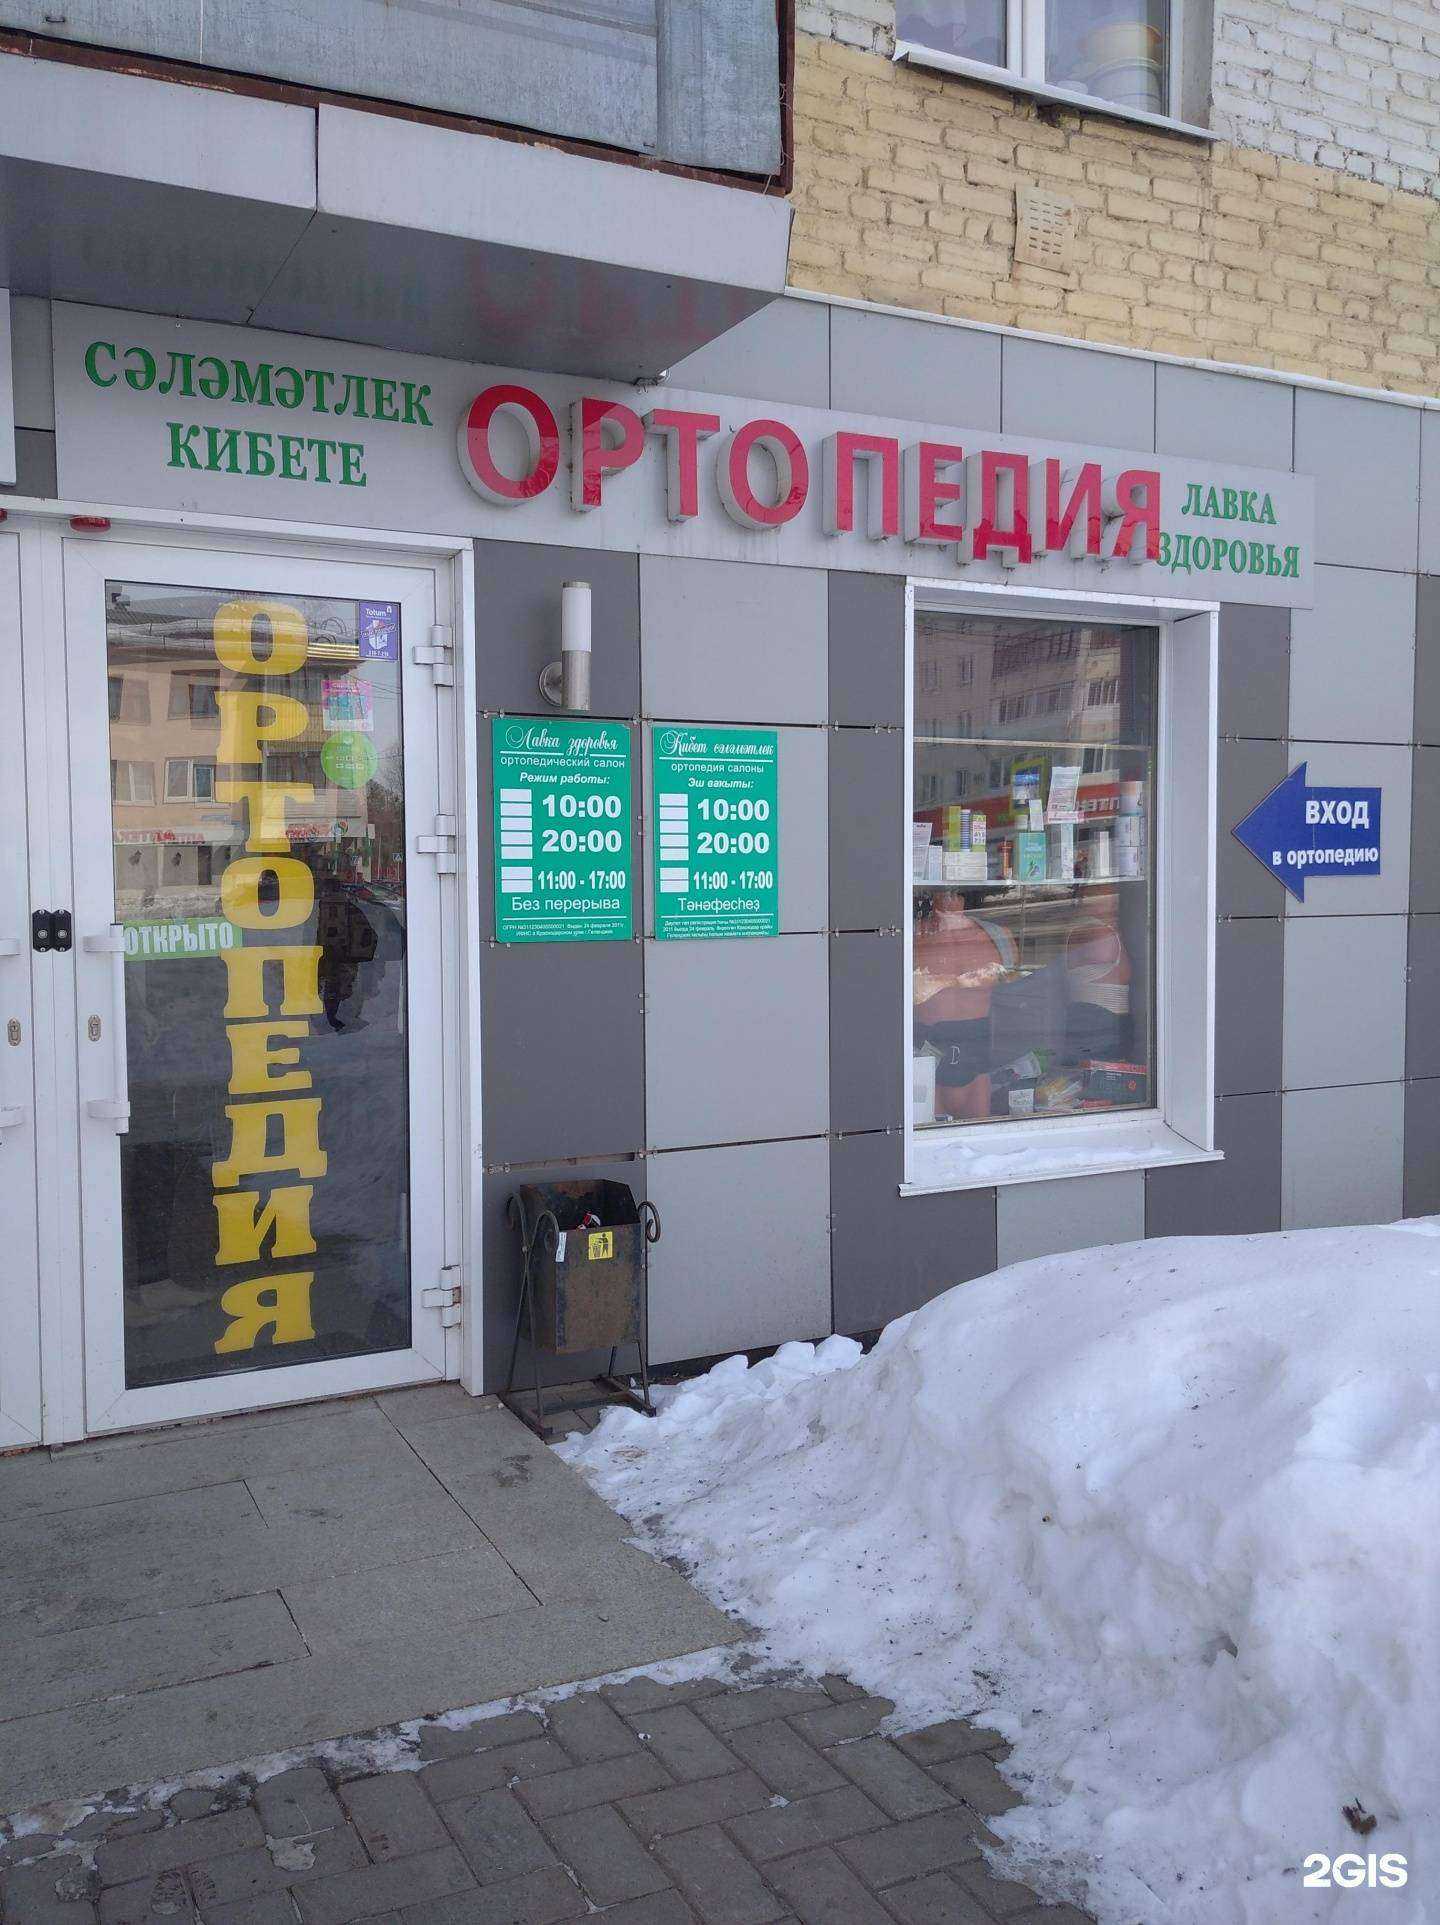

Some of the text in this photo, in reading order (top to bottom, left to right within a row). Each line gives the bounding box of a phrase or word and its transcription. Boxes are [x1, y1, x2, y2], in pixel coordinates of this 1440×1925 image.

[84, 341, 434, 427] СӘЛӘМӘТЛЕК
[166, 422, 367, 488] КИБЕТЕ
[466, 384, 1161, 565] ОРТОПЕДИЯ
[1181, 483, 1277, 525] ЛАВКА
[1157, 531, 1299, 578] ЗДОРОВЬЯ
[505, 725, 619, 757] Лавка здоровья
[500, 755, 626, 768] ортопедический салон
[671, 763, 725, 773] ортопедия
[519, 772, 610, 785] Режим работы:
[687, 777, 705, 788] Эш
[542, 794, 622, 818] 10:00
[697, 799, 770, 821] 10:00
[1305, 800, 1370, 829] ВХОД
[541, 829, 622, 853] 20:00
[696, 832, 770, 854] 20:00
[1272, 847, 1379, 870] в ортопедию
[537, 870, 576, 890] 11:00
[588, 870, 626, 889] 17:00
[693, 871, 728, 890] 11:00
[739, 870, 773, 889] 17:00
[511, 896, 620, 912] Без перерыва
[124, 922, 234, 955] ОТКРЫТО
[211, 601, 330, 1354] ОРТОПЕДИЯ
